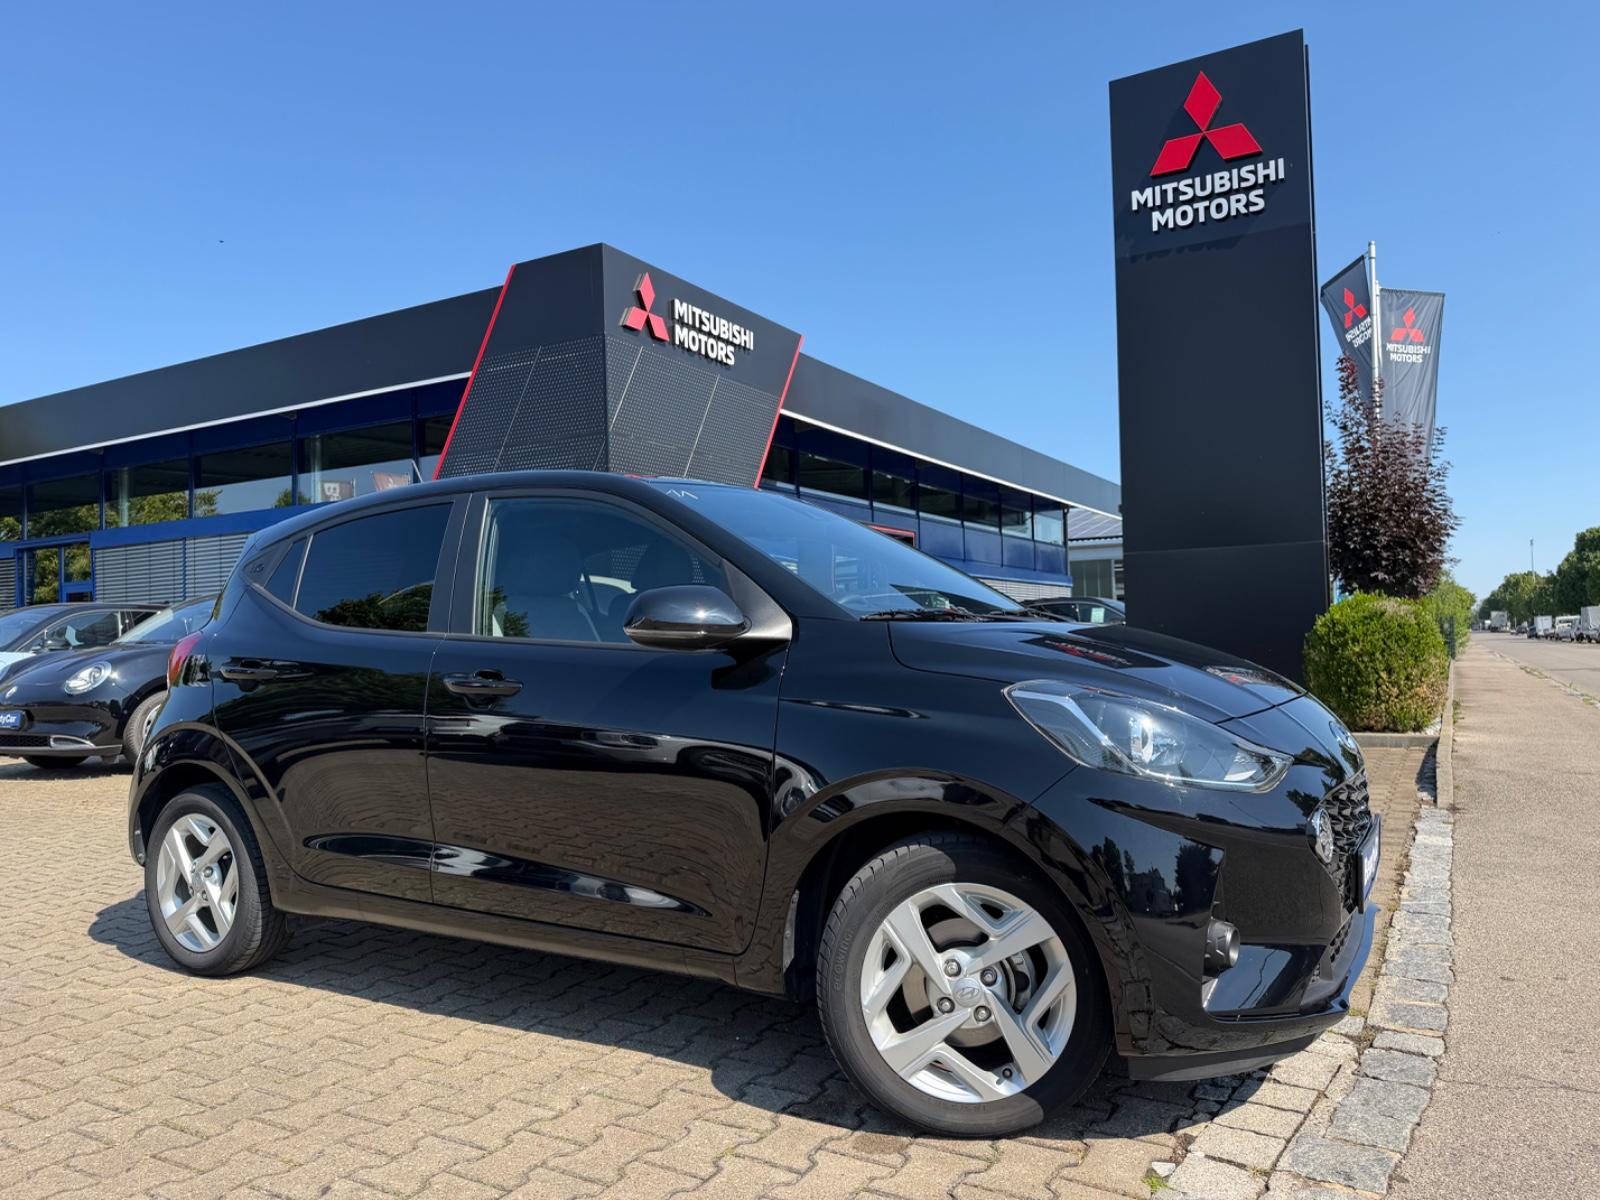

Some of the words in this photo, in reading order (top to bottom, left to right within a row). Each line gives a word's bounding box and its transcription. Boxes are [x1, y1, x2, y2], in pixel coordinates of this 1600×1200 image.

[1131, 158, 1285, 211] MITSUBISHI
[1152, 189, 1265, 232] MOTORS
[673, 298, 754, 350] MITSUBISHI
[673, 324, 735, 365] MOTORS
[1386, 343, 1431, 354] MITSUBISHI
[1390, 353, 1423, 363] MOTORS
